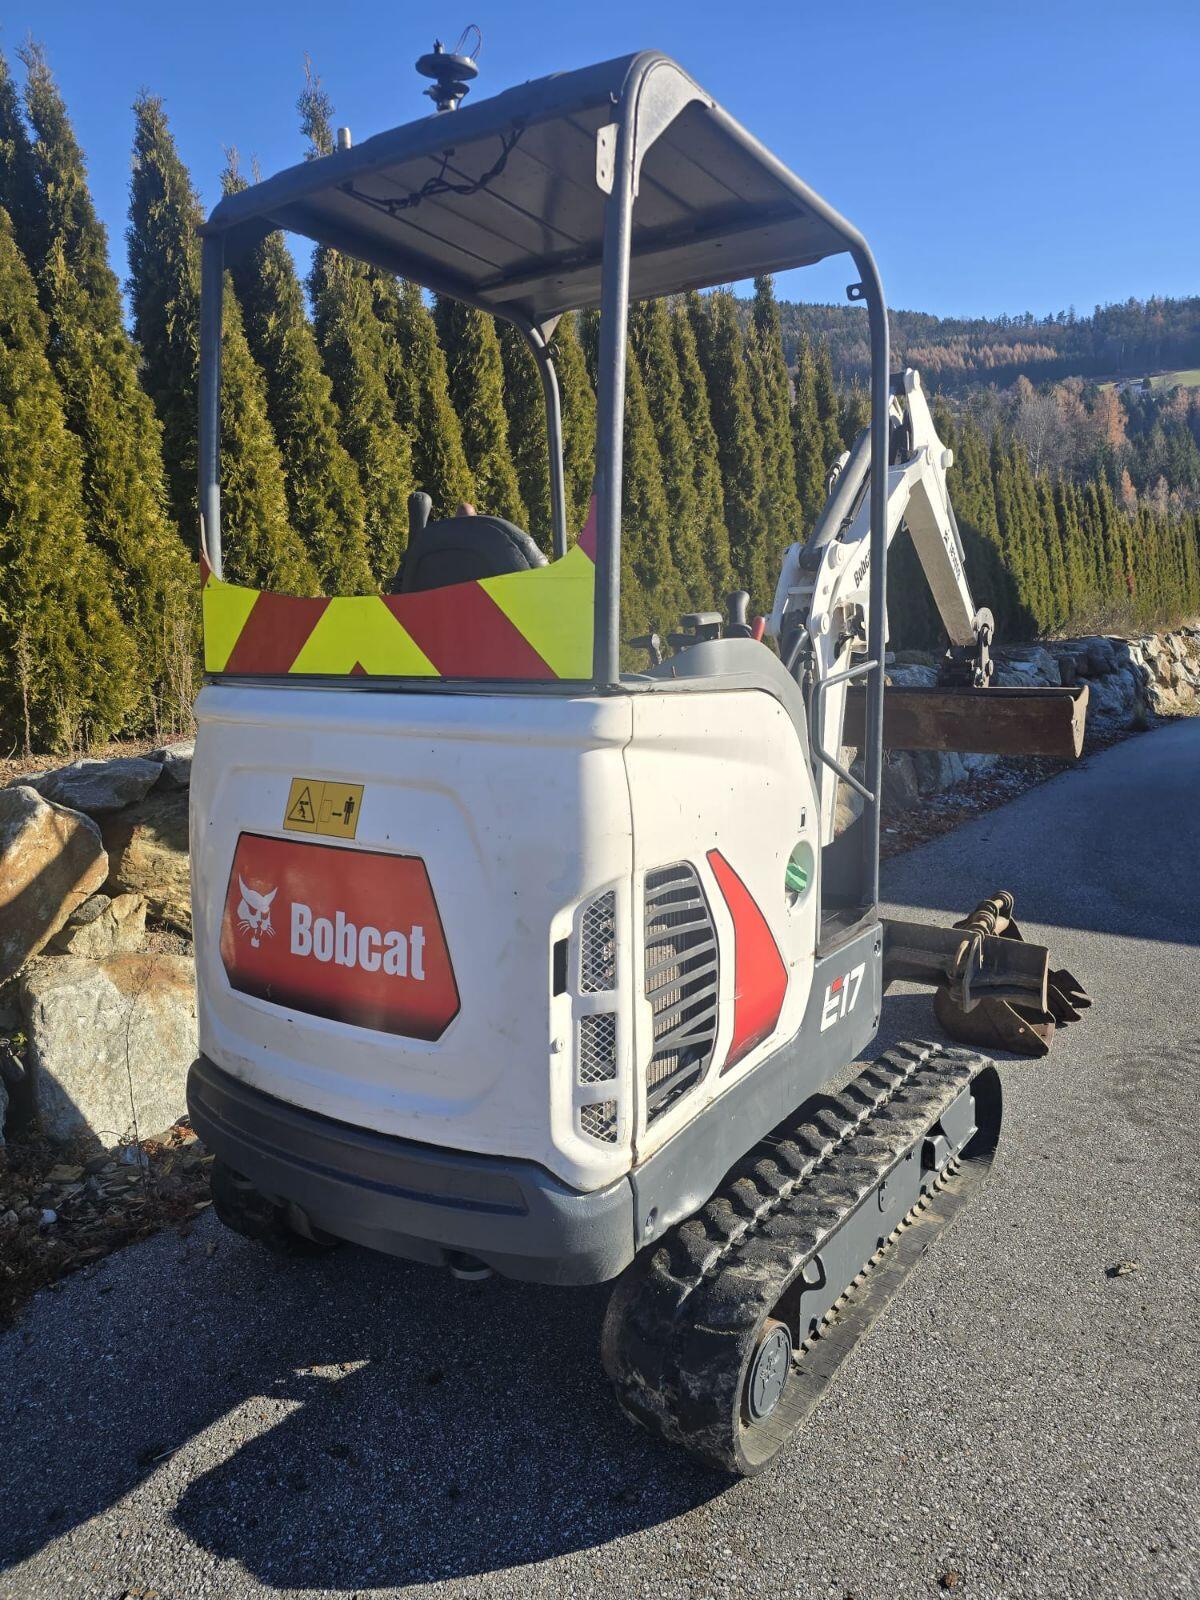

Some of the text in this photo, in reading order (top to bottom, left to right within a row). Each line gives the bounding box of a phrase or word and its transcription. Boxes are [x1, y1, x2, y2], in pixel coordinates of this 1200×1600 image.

[853, 549, 870, 589] Bobc
[290, 902, 426, 981] Bobcat
[820, 962, 866, 1033] E17
